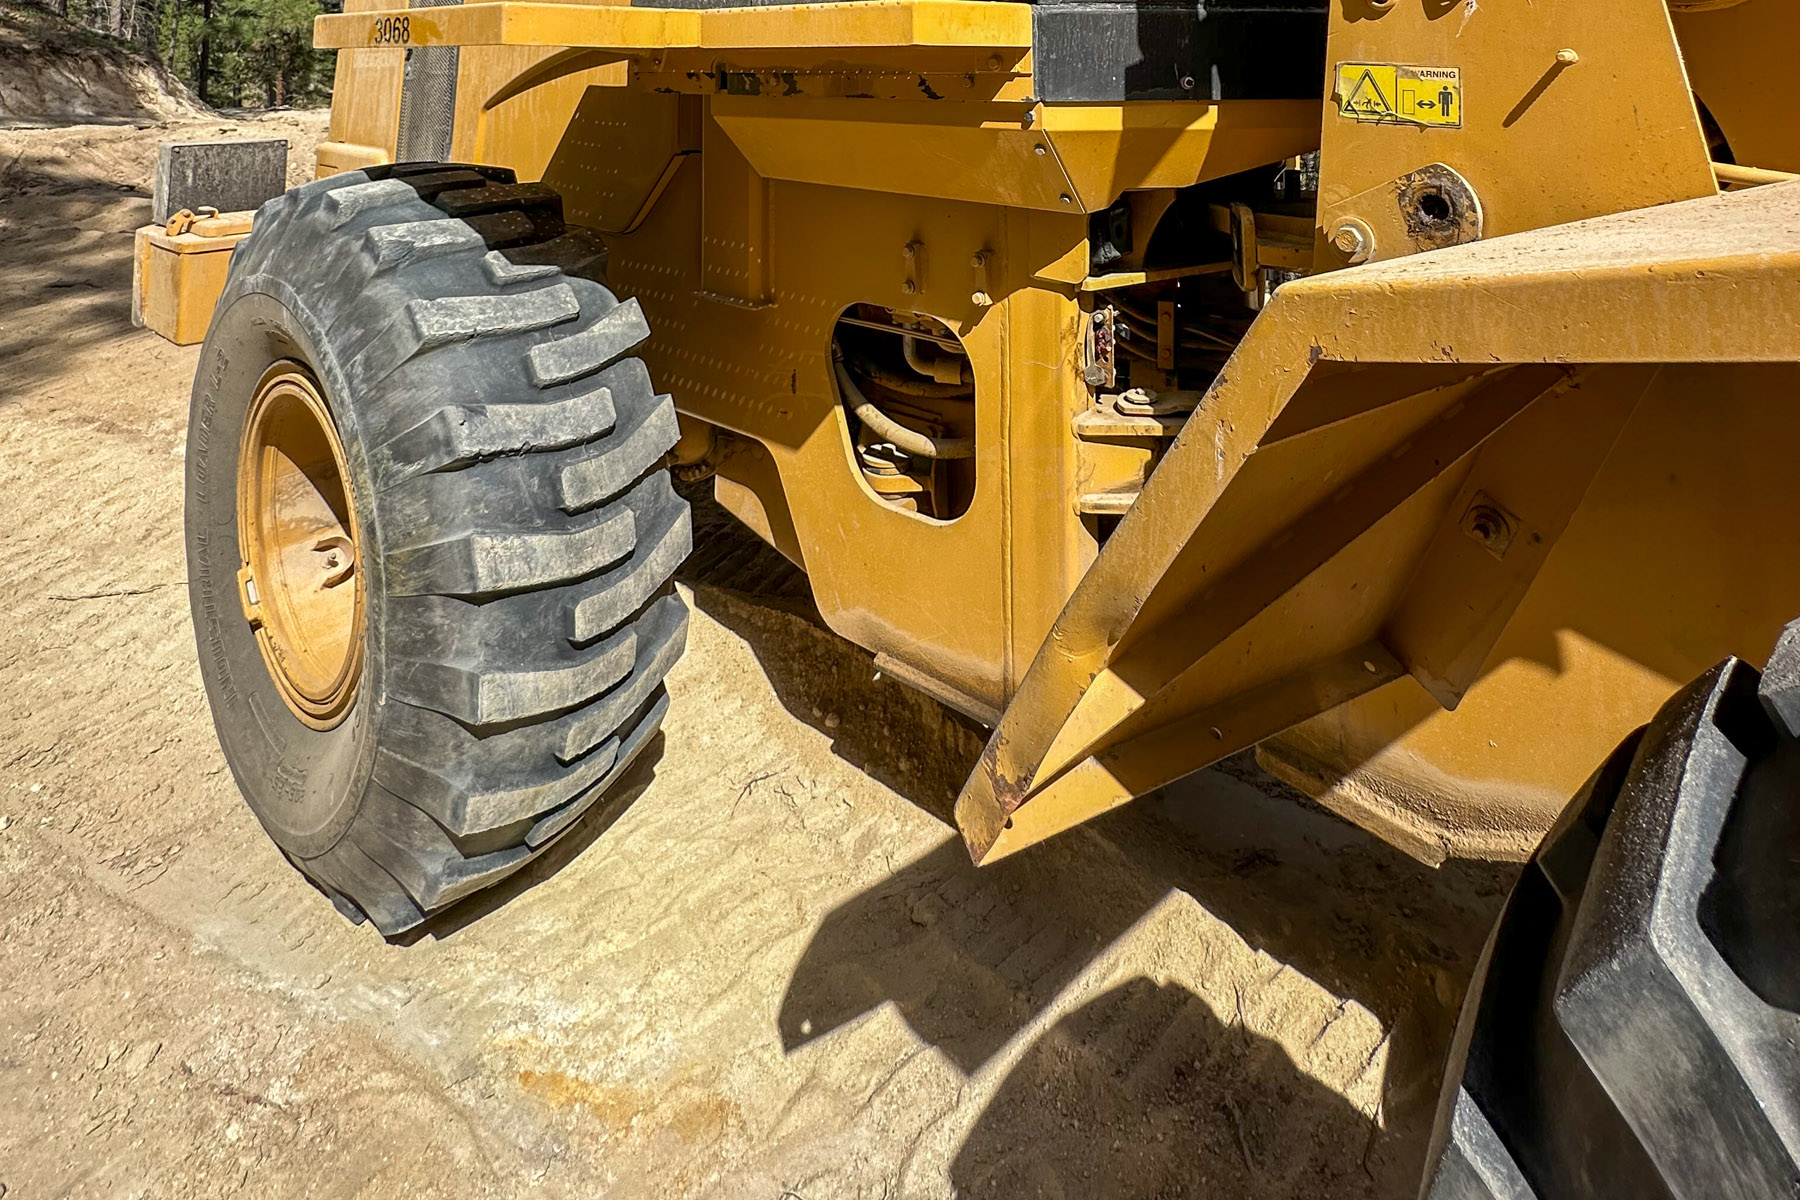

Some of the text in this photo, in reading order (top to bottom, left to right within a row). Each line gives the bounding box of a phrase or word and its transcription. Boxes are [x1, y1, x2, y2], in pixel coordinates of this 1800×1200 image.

[375, 16, 410, 45] 3068
[196, 393, 217, 506] LOADER
[196, 527, 239, 709] INDUSTRIAL
